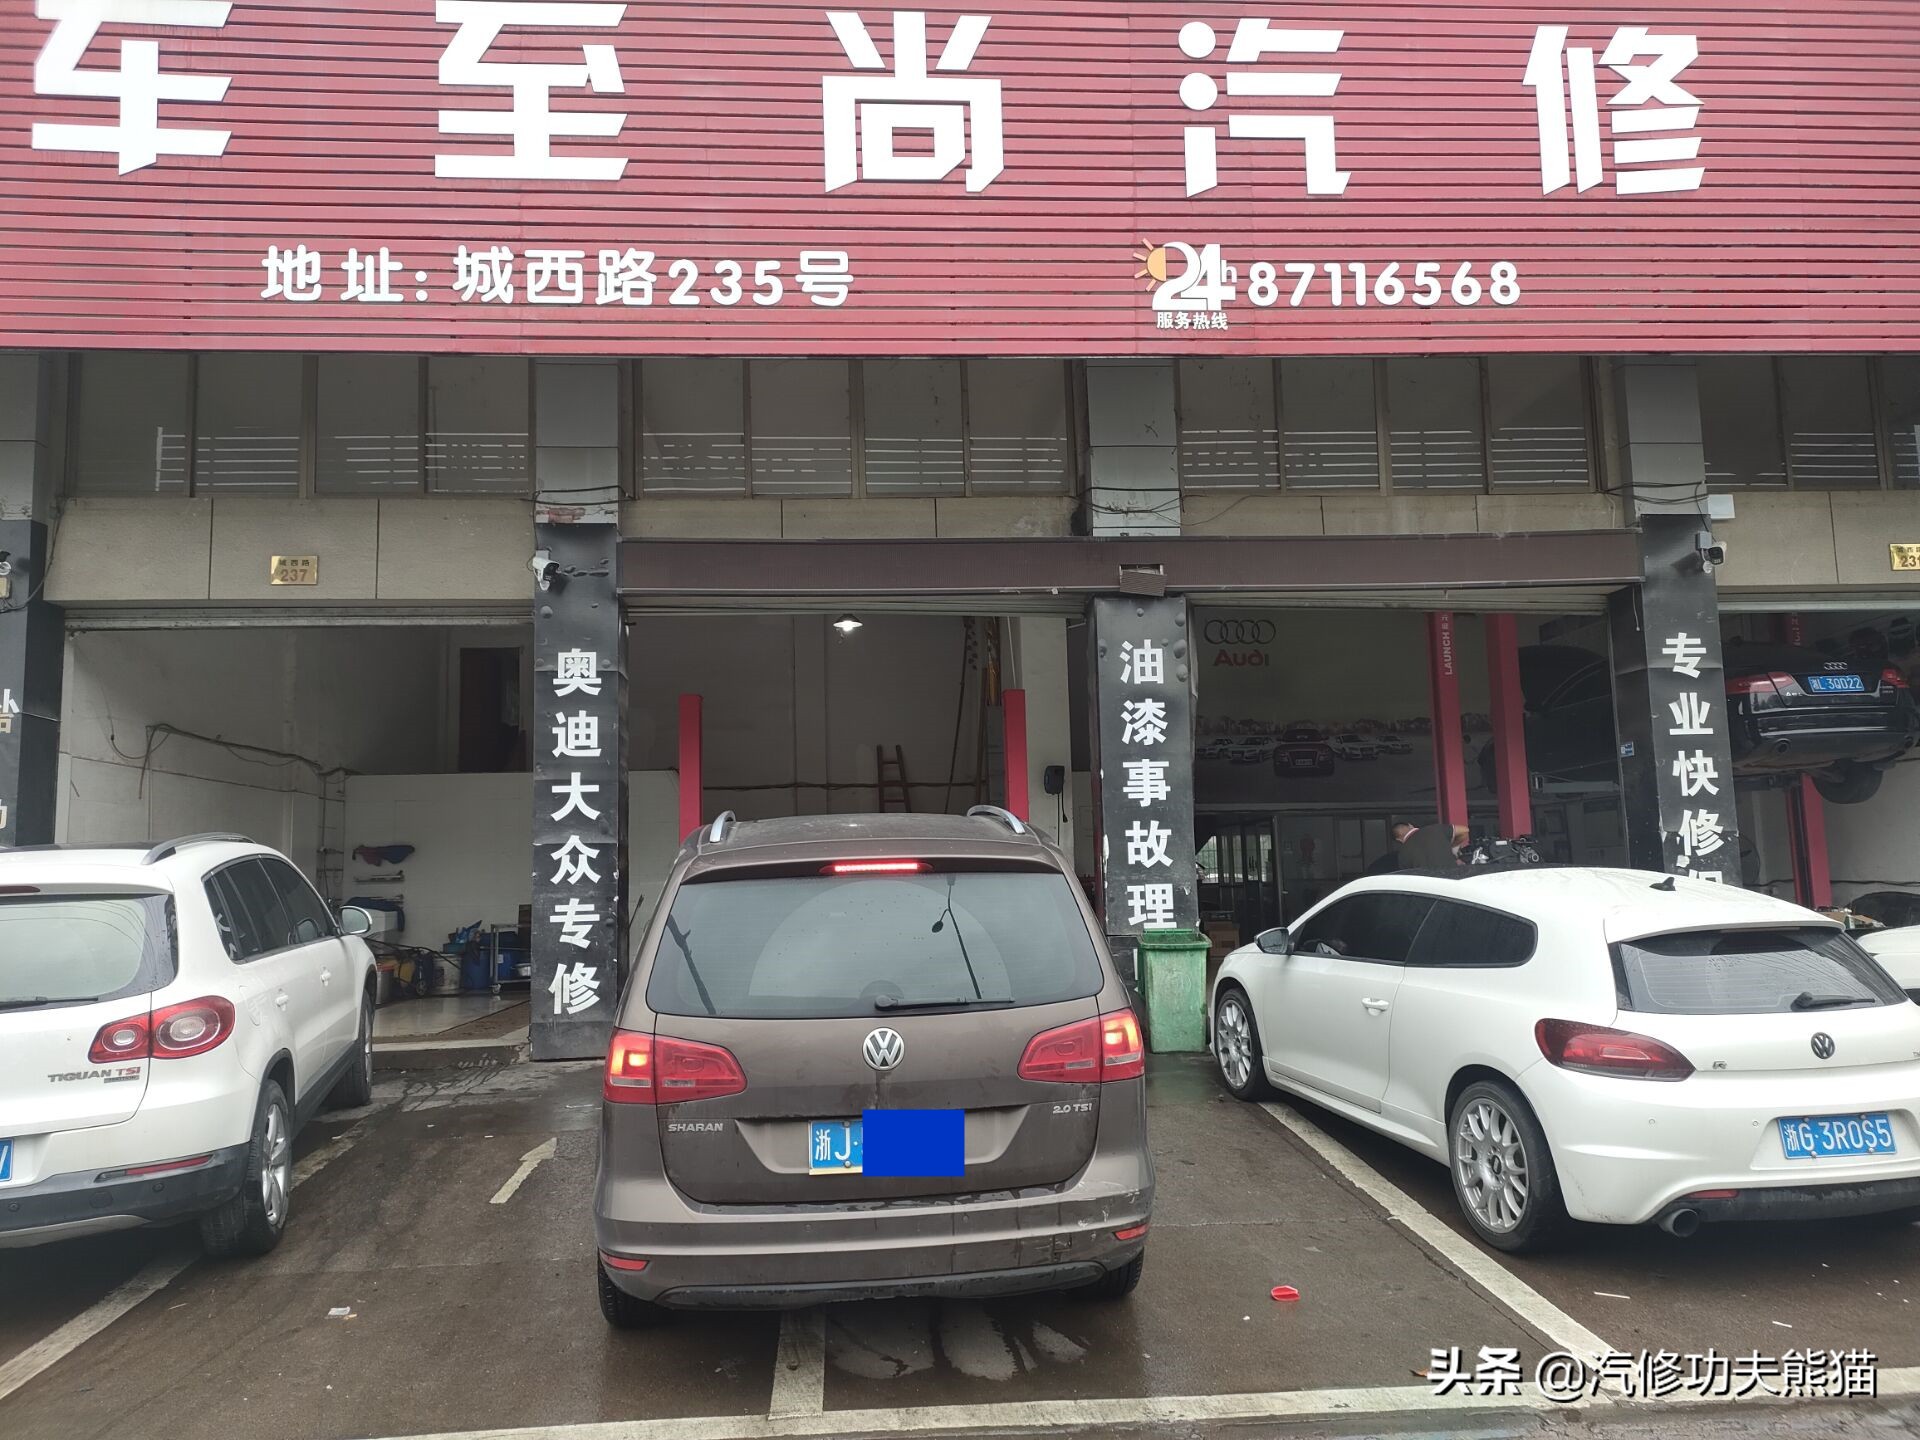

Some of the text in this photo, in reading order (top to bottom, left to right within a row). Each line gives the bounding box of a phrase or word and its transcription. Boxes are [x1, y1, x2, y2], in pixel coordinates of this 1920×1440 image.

[32, 0, 1705, 197] 车至尚汽修
[1248, 262, 1520, 306] 87116568
[1157, 312, 1229, 330] 服务热线
[280, 569, 308, 582] 237
[1214, 648, 1270, 667] Audi
[1441, 631, 1453, 676] LAUNCH
[548, 648, 602, 1015] 奥迪大众专修
[48, 1069, 112, 1083] TIGUAN
[116, 1066, 141, 1076] TSI
[667, 1121, 724, 1133] SHARAN
